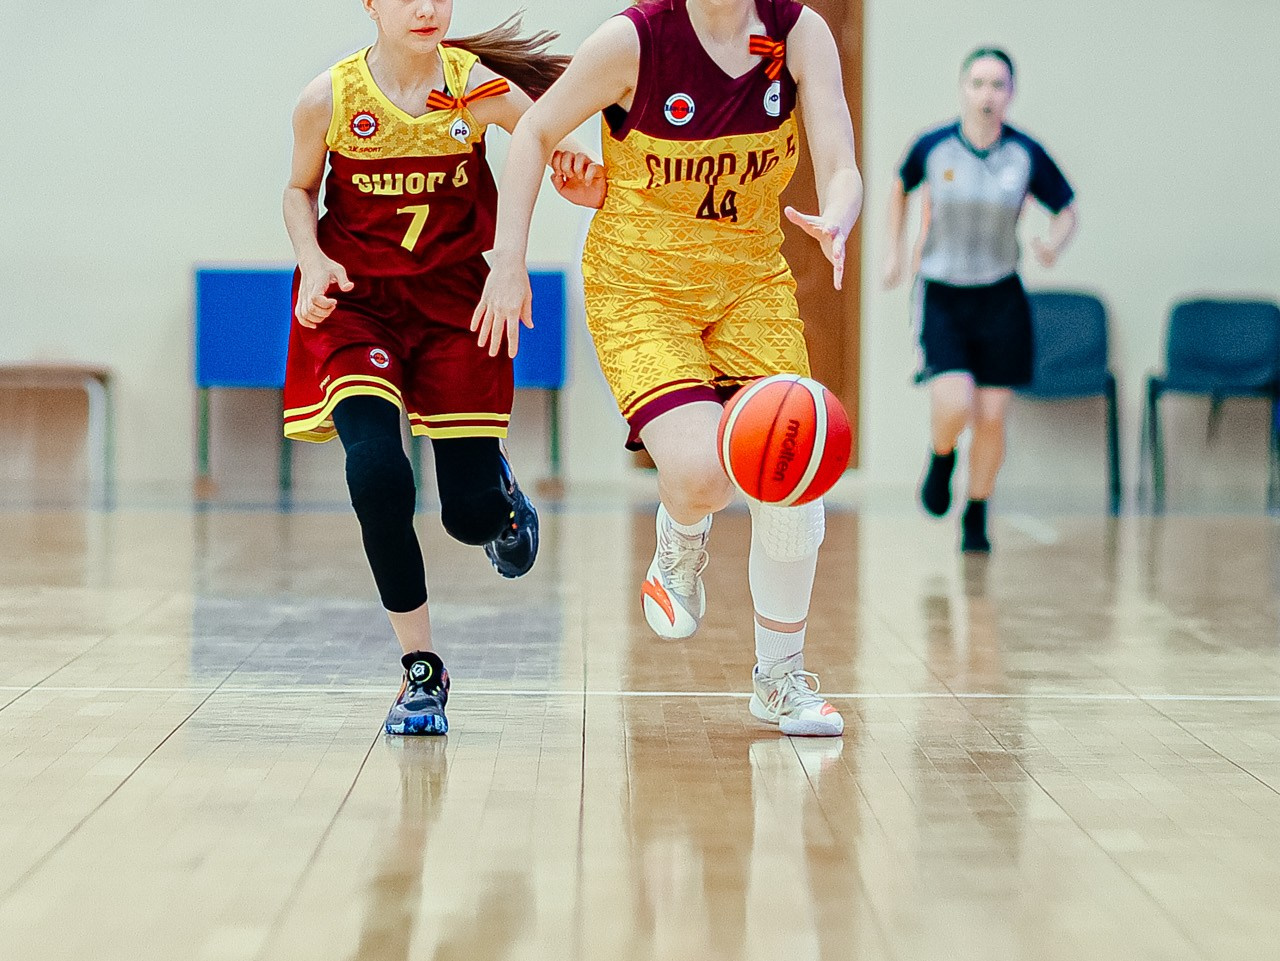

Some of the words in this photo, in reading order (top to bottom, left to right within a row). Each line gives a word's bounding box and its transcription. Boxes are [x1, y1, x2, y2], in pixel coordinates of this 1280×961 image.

[696, 184, 738, 223] 44
[396, 204, 429, 252] 7
[773, 419, 800, 482] molten
